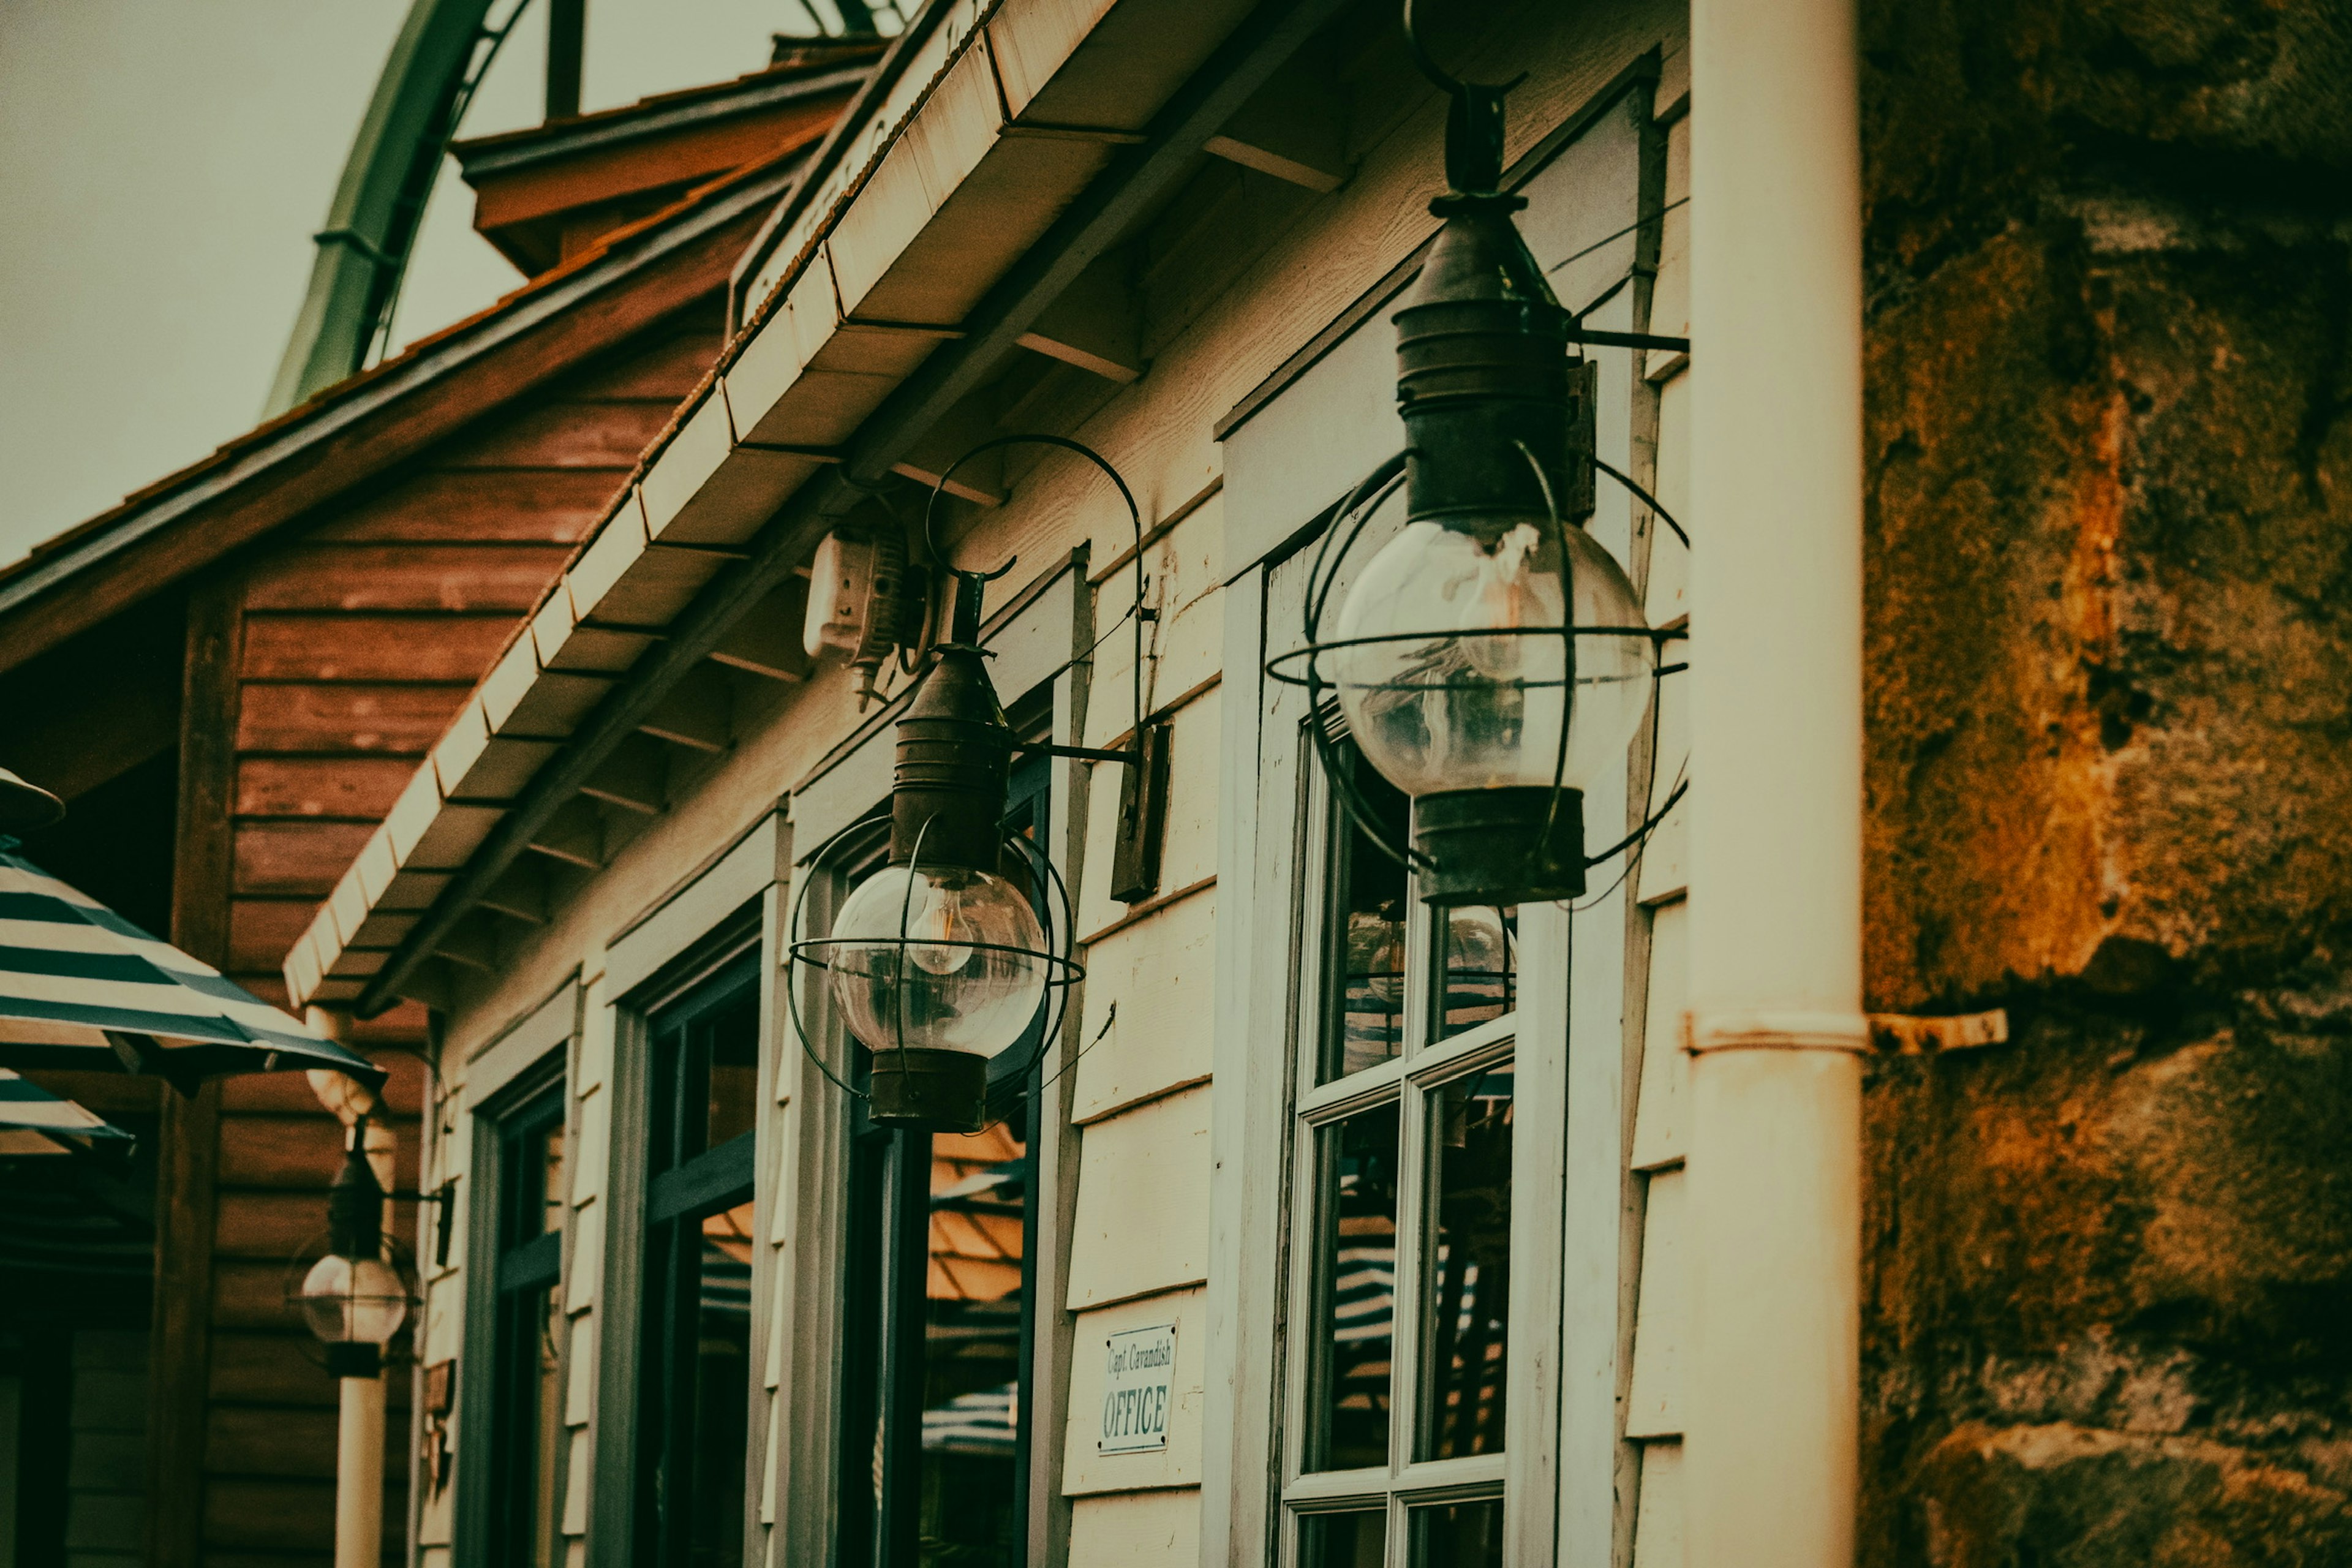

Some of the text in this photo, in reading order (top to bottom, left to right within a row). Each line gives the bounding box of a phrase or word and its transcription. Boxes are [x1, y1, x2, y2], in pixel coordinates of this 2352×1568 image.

[1107, 1338, 1170, 1380] Capt. Cavandish
[1103, 1385, 1167, 1439] OFFICE
